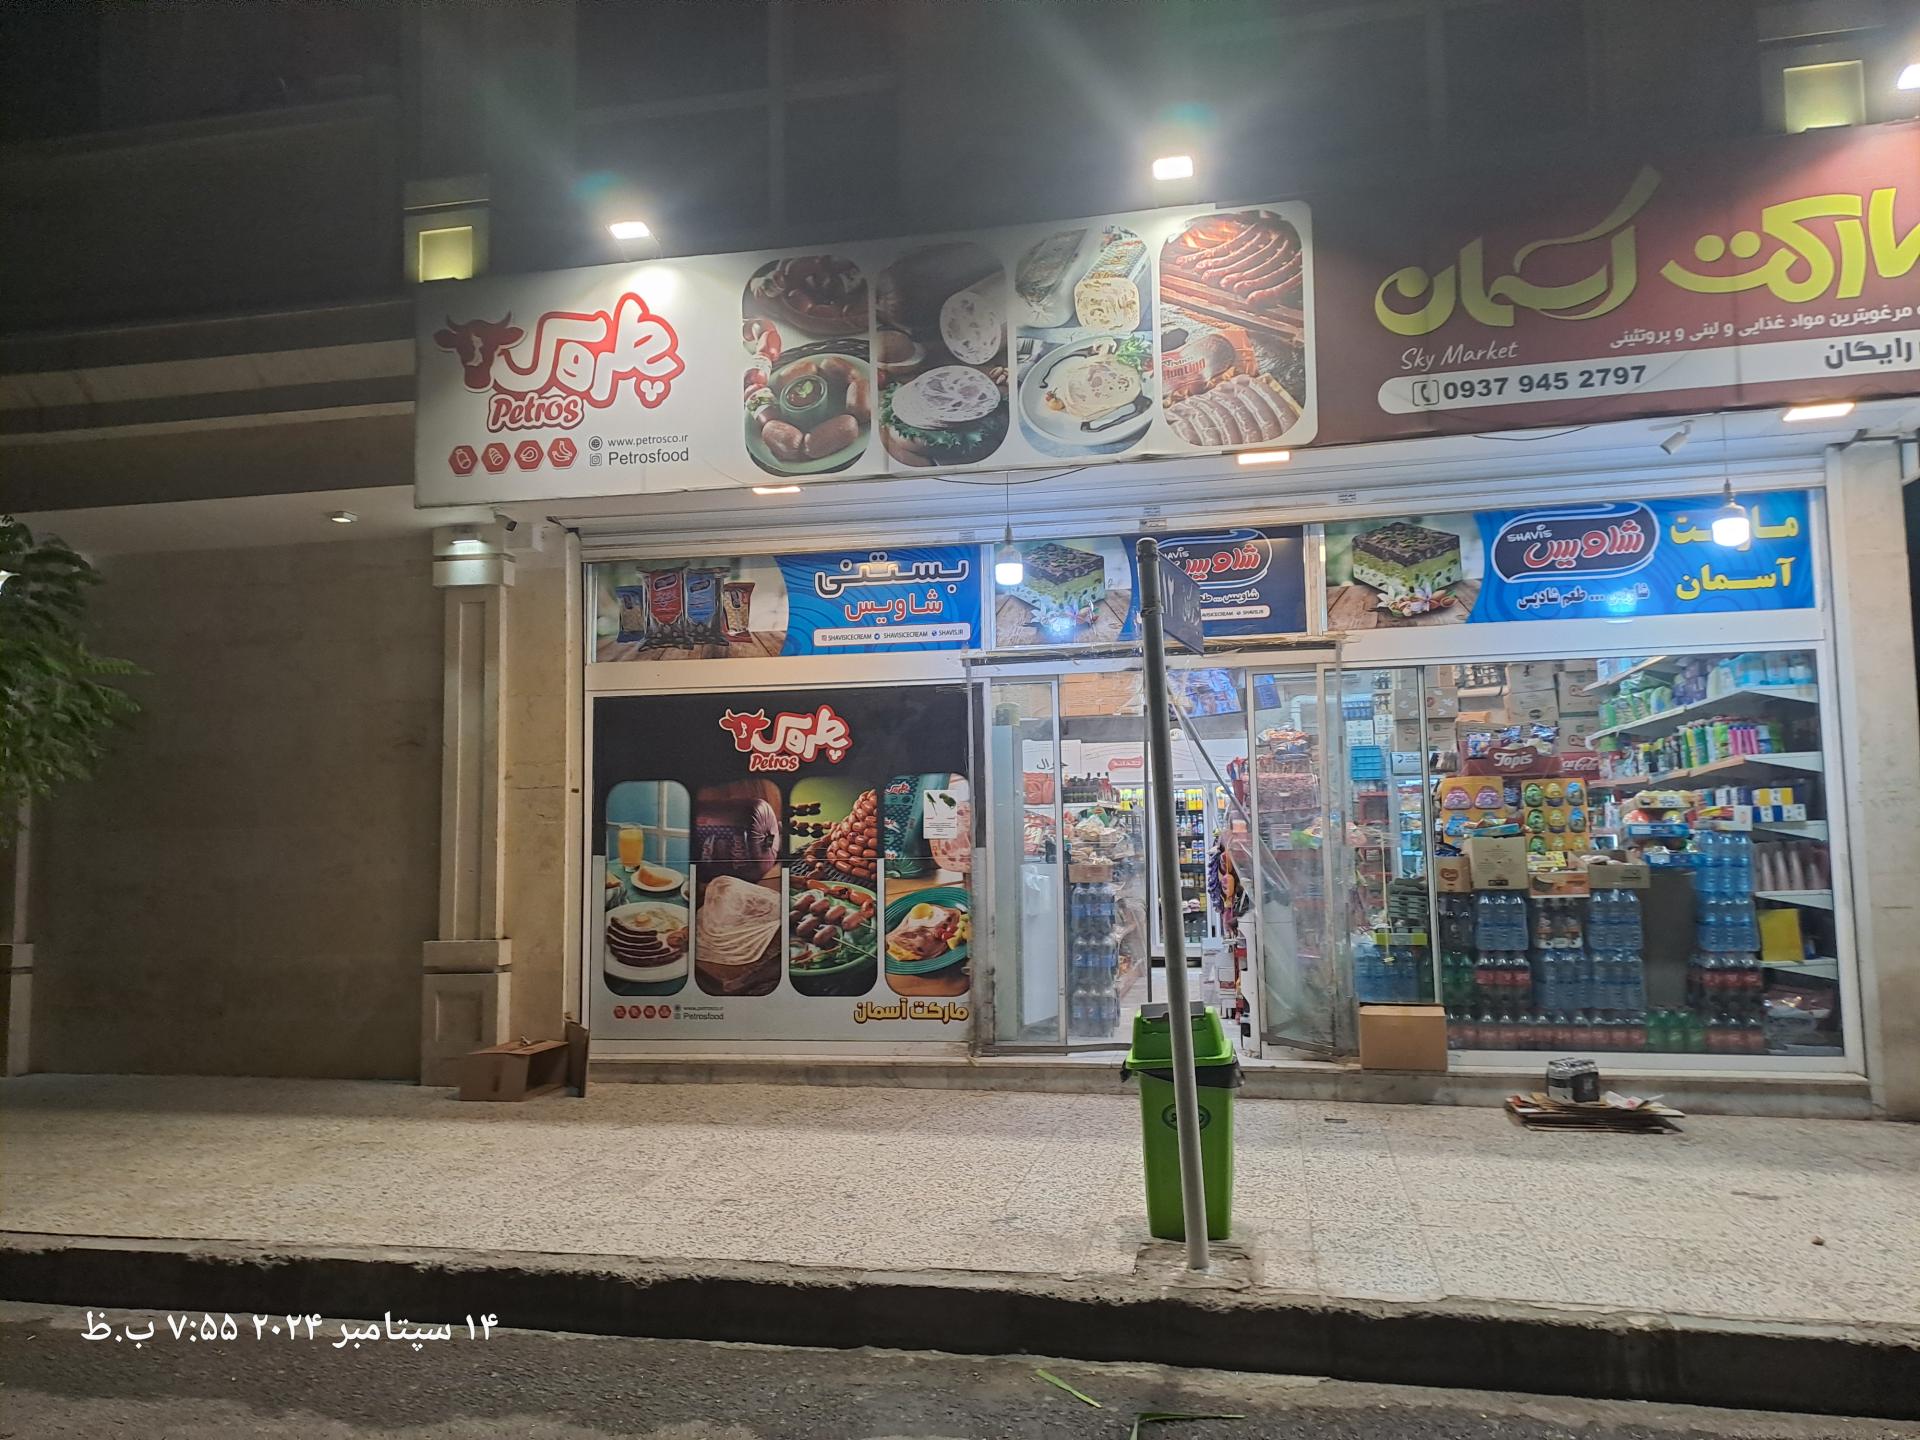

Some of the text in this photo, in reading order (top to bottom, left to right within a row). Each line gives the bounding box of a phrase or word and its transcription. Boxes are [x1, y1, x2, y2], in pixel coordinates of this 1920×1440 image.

[1674, 328, 1684, 340] و
[1689, 322, 1719, 343] لبنی
[1723, 325, 1734, 337] و
[1738, 313, 1785, 337] غذایی
[1789, 313, 1825, 329] مواد
[1400, 340, 1519, 371] Sky Market
[1443, 365, 1647, 400] 0937 945 2797
[488, 391, 583, 432] Petros
[607, 434, 689, 448] www.petrosco.ir
[608, 448, 690, 466] Petrosfood
[1506, 524, 1553, 542] SHAVIS
[1670, 505, 1799, 551] مات
[1522, 518, 1646, 569] شاویس
[815, 551, 969, 598] بستنی
[1676, 556, 1797, 600] آسمان
[844, 589, 944, 623] شاویس
[748, 753, 800, 773] Petros
[853, 997, 969, 1025] مارکت آسمان
